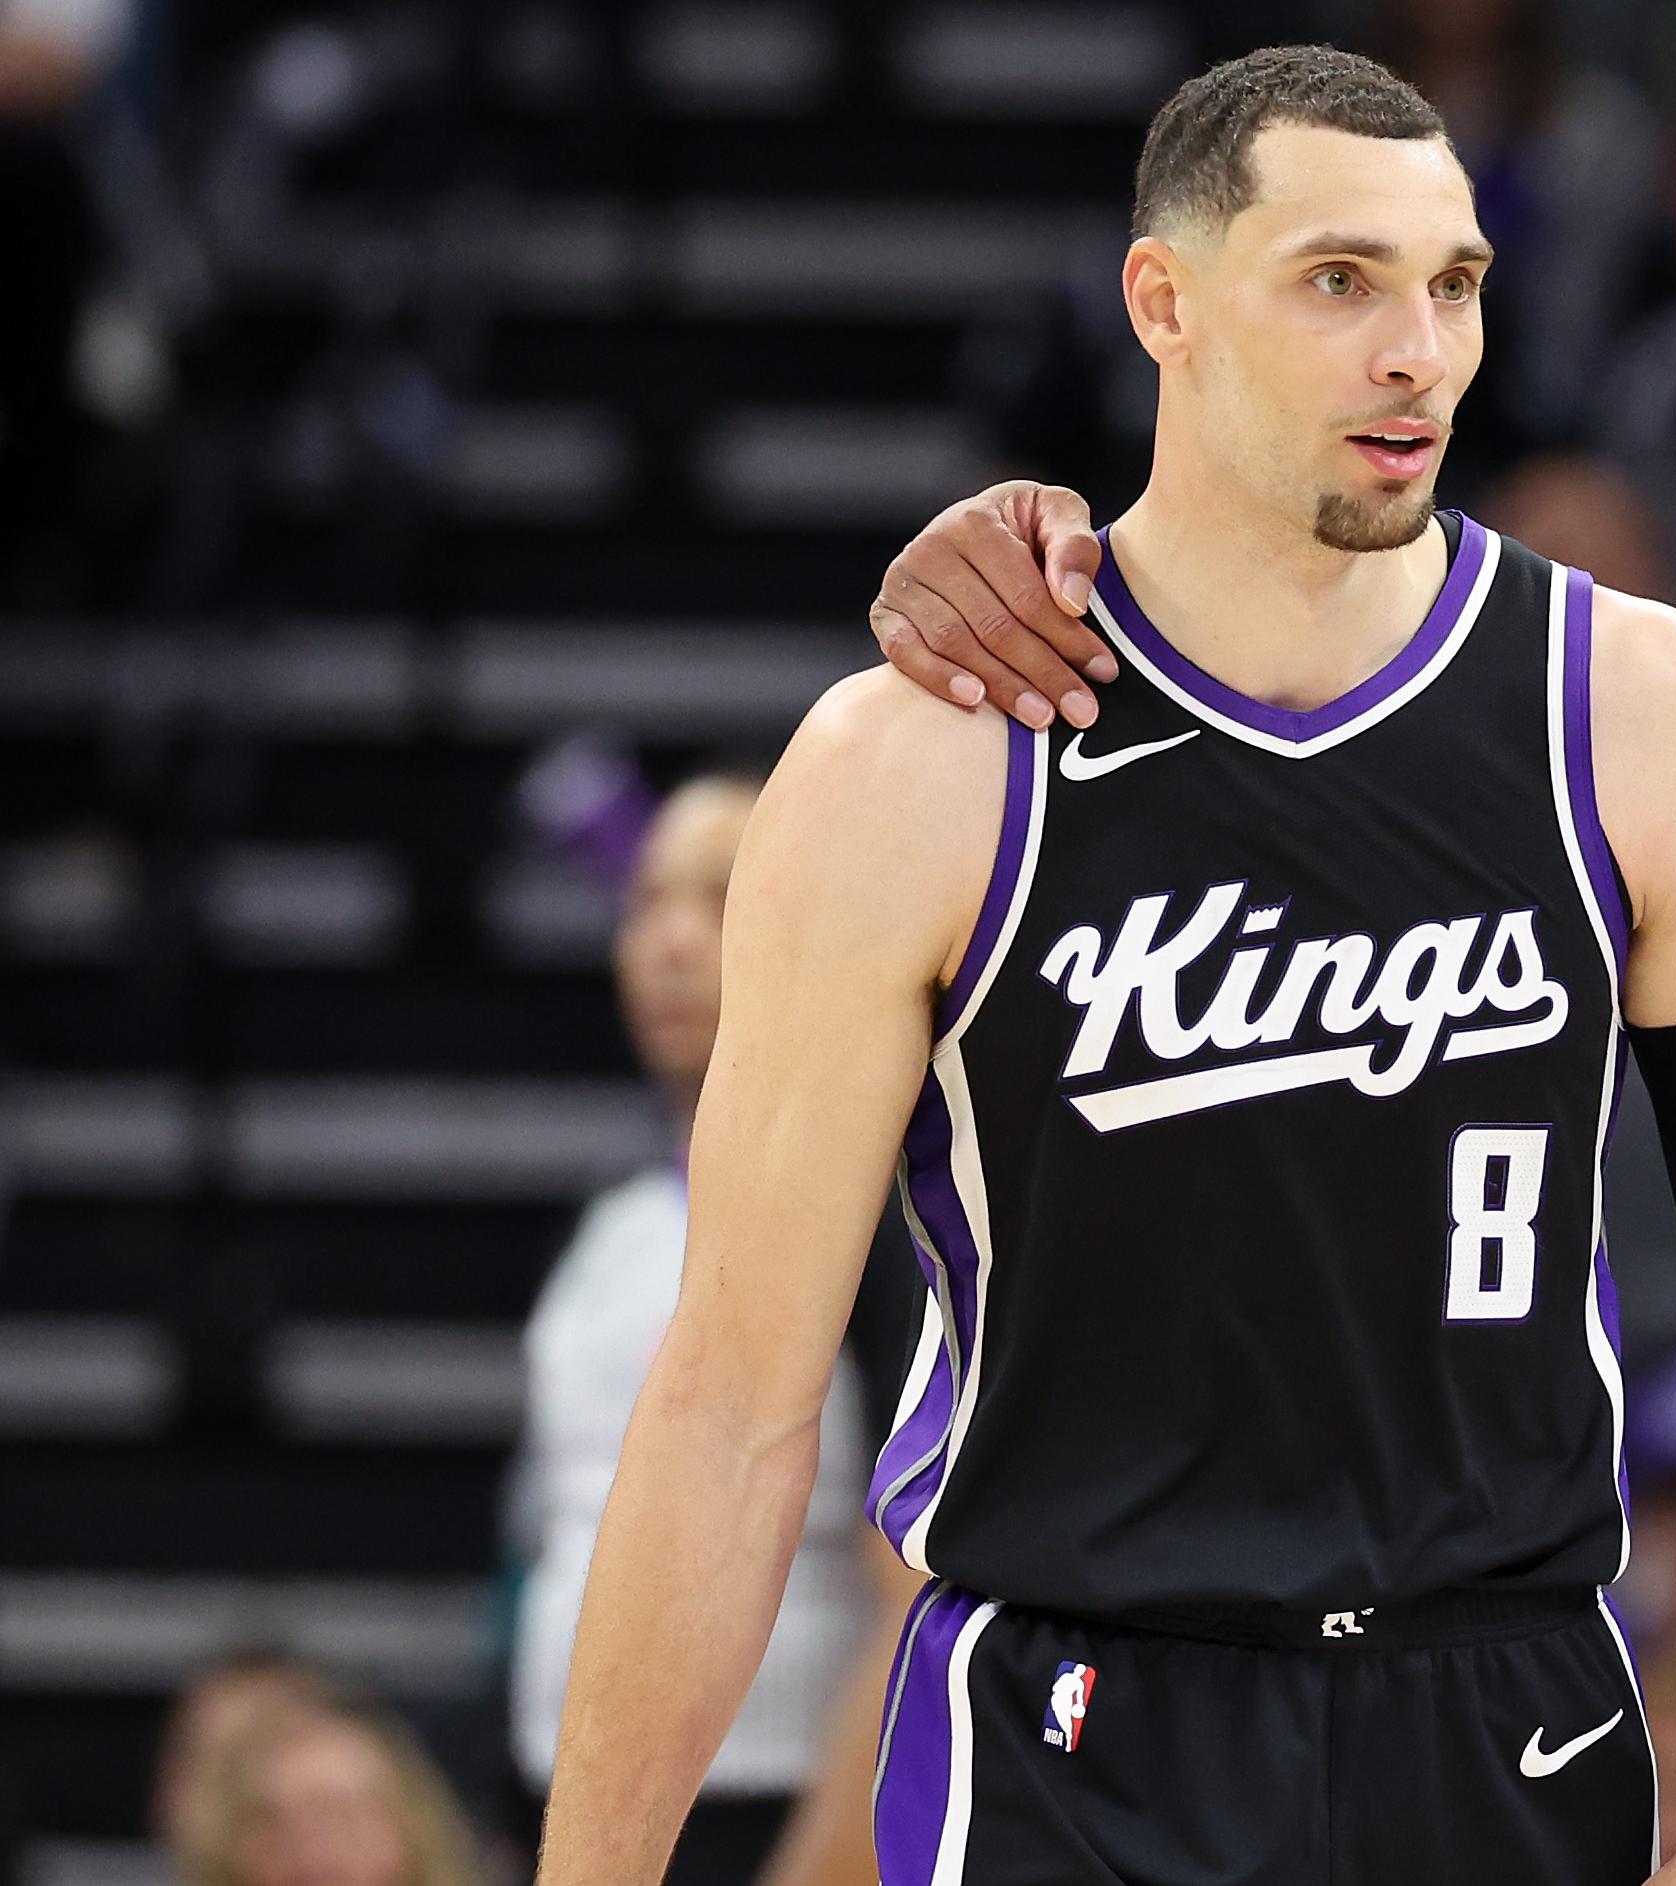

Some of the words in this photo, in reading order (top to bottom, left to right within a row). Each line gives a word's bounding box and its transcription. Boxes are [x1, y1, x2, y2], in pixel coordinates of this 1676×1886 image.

[1037, 879, 1570, 1135] Kings
[1442, 1122, 1553, 1326] 8
[1043, 1727, 1064, 1747] NBA
